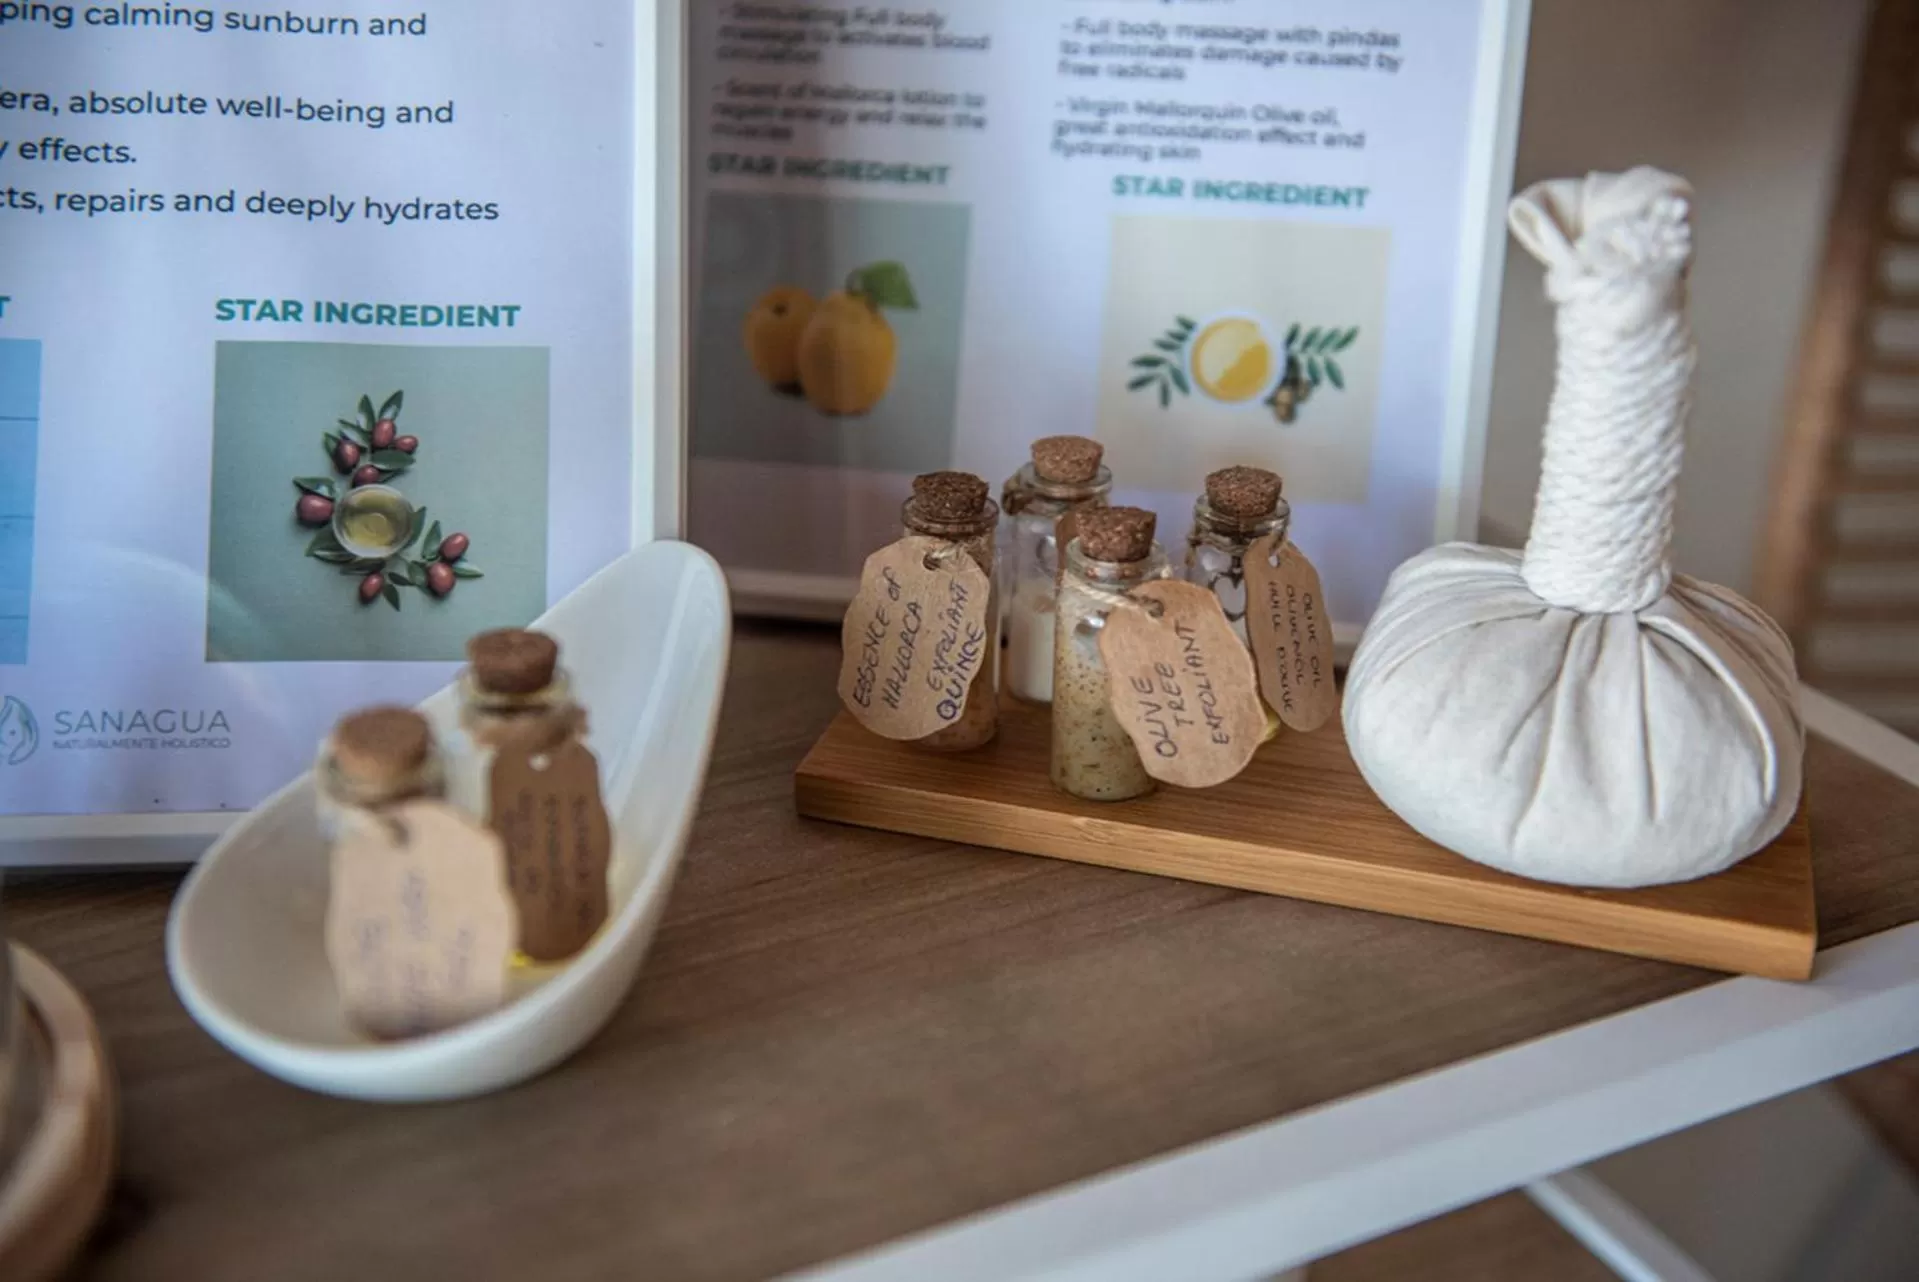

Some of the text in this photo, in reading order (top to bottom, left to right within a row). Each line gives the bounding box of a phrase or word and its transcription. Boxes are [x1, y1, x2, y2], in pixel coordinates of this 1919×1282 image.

[84, 2, 214, 33] calming
[224, 9, 359, 35] sunburn
[369, 13, 427, 36] and
[1074, 18, 1111, 35] Full
[1118, 21, 1167, 39] body
[1176, 24, 1268, 44] massage
[1276, 26, 1322, 43] with
[69, 90, 207, 115] absolute
[217, 96, 386, 128] well-being
[395, 101, 454, 123] and
[18, 137, 137, 164] effects.
[1323, 130, 1366, 149] and
[55, 188, 165, 217] repairs
[174, 190, 236, 214] and
[245, 192, 355, 222] deeply
[364, 197, 500, 226] hydrates
[1112, 174, 1370, 209] STAR INGREDIENT
[215, 298, 522, 327] STAR INGREDIENT
[853, 606, 892, 709] ESSENCE
[1154, 661, 1195, 728] TREE
[54, 708, 231, 735] SANAGUA
